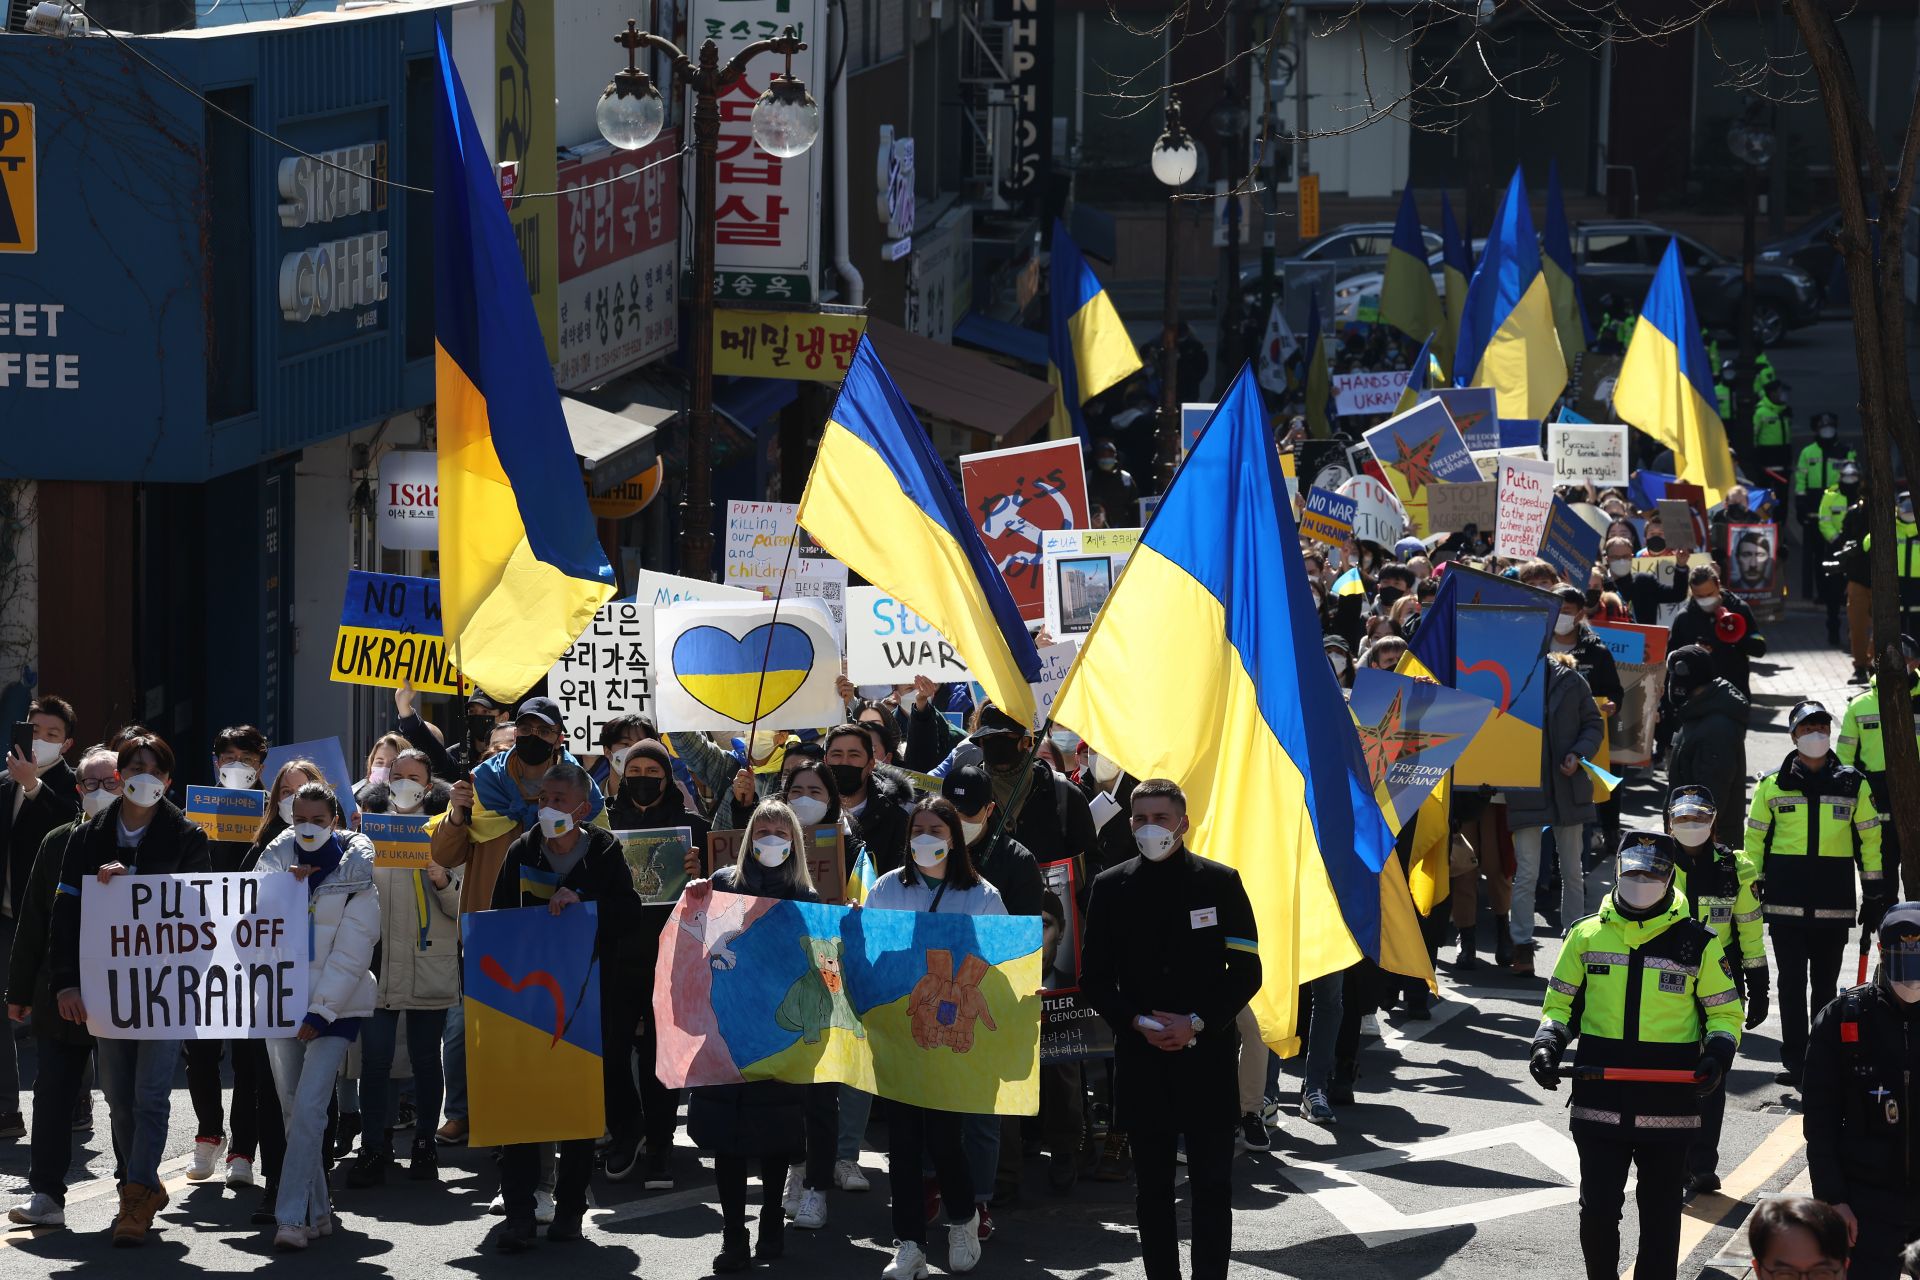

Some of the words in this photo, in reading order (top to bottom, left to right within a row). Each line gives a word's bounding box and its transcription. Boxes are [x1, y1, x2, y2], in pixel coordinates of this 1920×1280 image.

[278, 143, 376, 228] STREET
[566, 151, 666, 268] 장터국밥
[279, 230, 388, 323] COFFEE
[596, 275, 641, 346] 청송옥
[1340, 374, 1391, 391] HANDS
[388, 509, 406, 520] 이삭
[409, 508, 435, 519] 토스트
[733, 503, 773, 515] PUTIN
[1308, 494, 1326, 511] NO
[1329, 500, 1354, 522] WAR
[1303, 517, 1314, 530] IN
[732, 532, 753, 543] our
[1086, 534, 1108, 549] 제발
[728, 548, 755, 559] and
[364, 581, 407, 618] NO
[872, 598, 941, 637] Sto
[559, 642, 597, 674] 우리
[602, 642, 650, 678] 가족
[881, 641, 968, 673] WAR
[559, 679, 597, 713] 우리
[605, 677, 652, 712] 친구
[1391, 762, 1449, 776] FREEDOM
[1389, 774, 1441, 787] UKRAINE
[364, 822, 386, 833] STOP
[388, 824, 404, 833] THE
[389, 850, 430, 860] UKRAINE
[235, 918, 285, 949] OFF
[1663, 973, 1684, 986] 경찰
[1660, 983, 1684, 993] POLICE
[1041, 996, 1075, 1012] TLER
